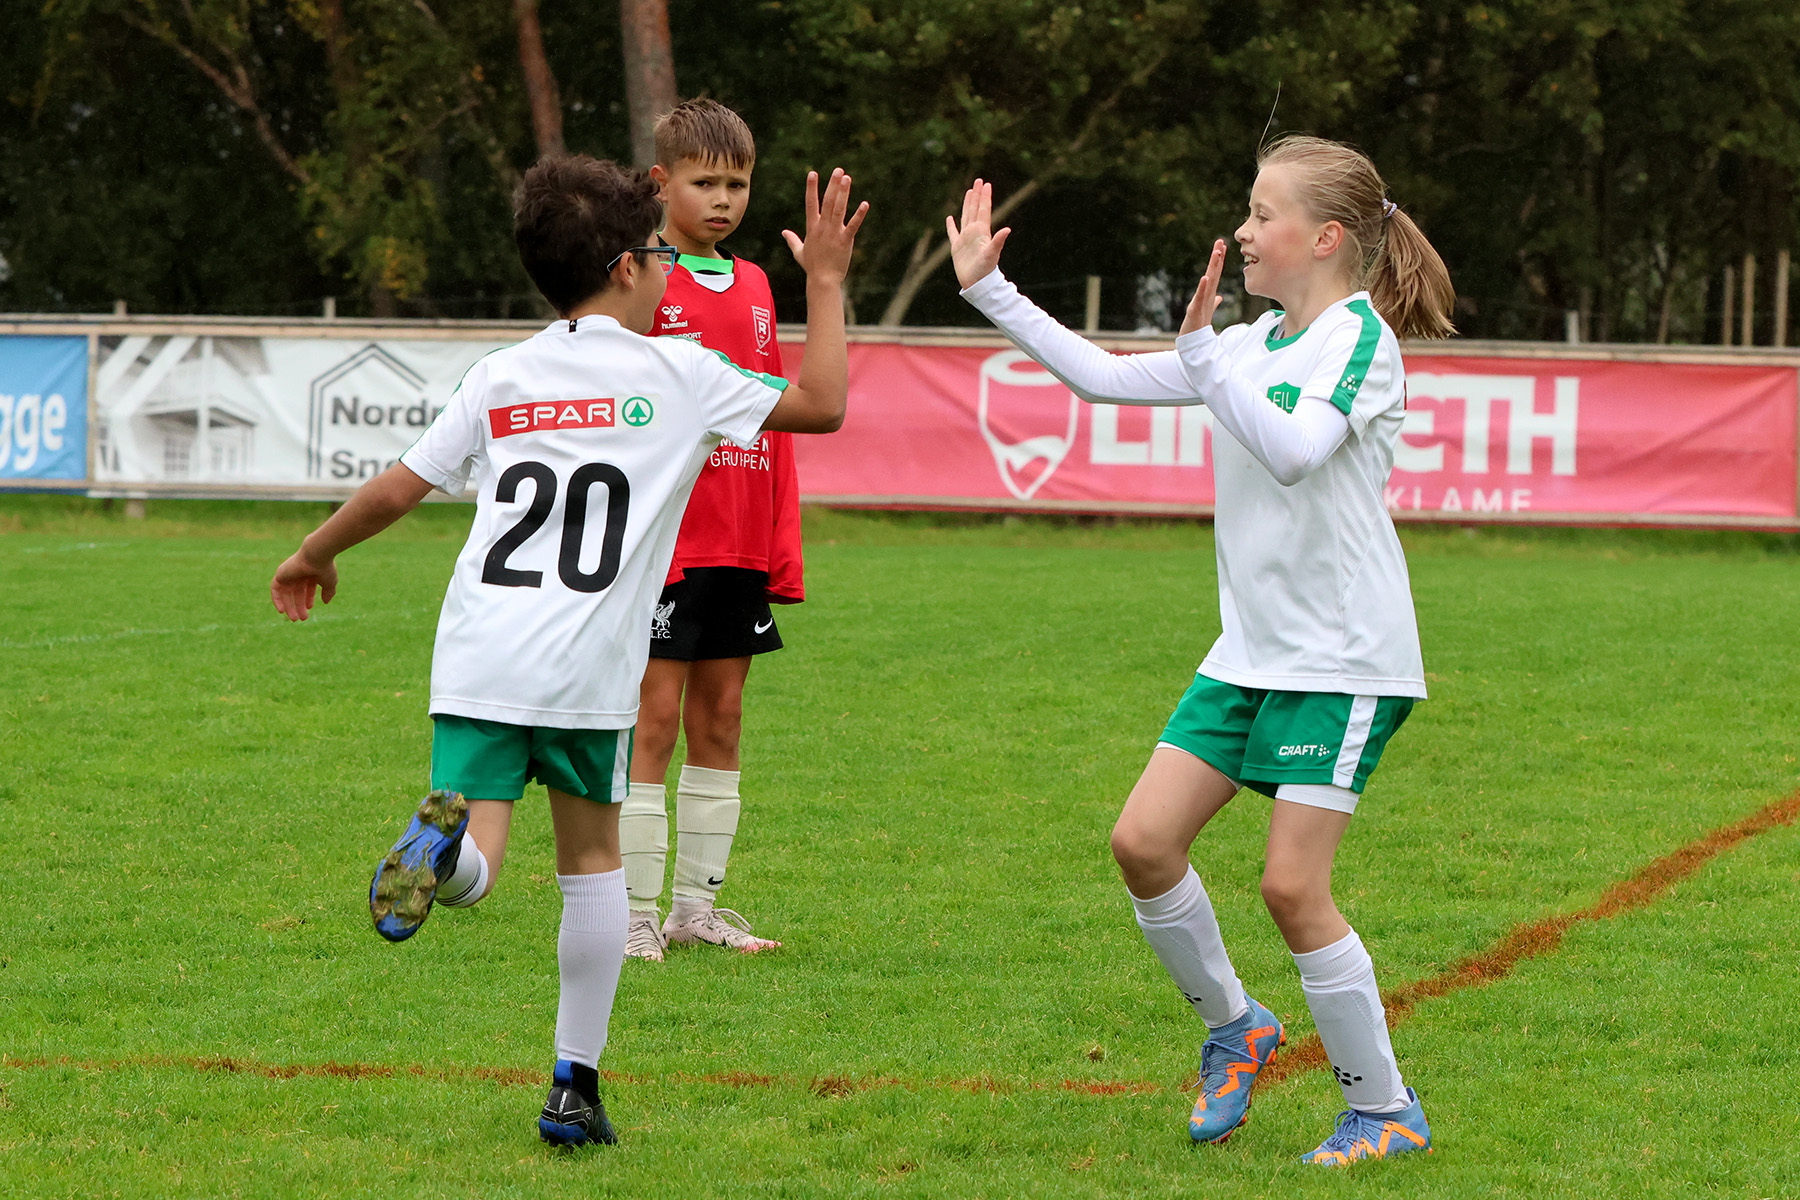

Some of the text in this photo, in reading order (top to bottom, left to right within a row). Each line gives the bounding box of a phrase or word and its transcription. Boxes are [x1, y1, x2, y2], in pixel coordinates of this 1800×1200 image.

[661, 320, 689, 329] hummel
[509, 403, 612, 430] SPAR
[481, 461, 631, 593] 20
[1278, 745, 1318, 756] CRAFT
